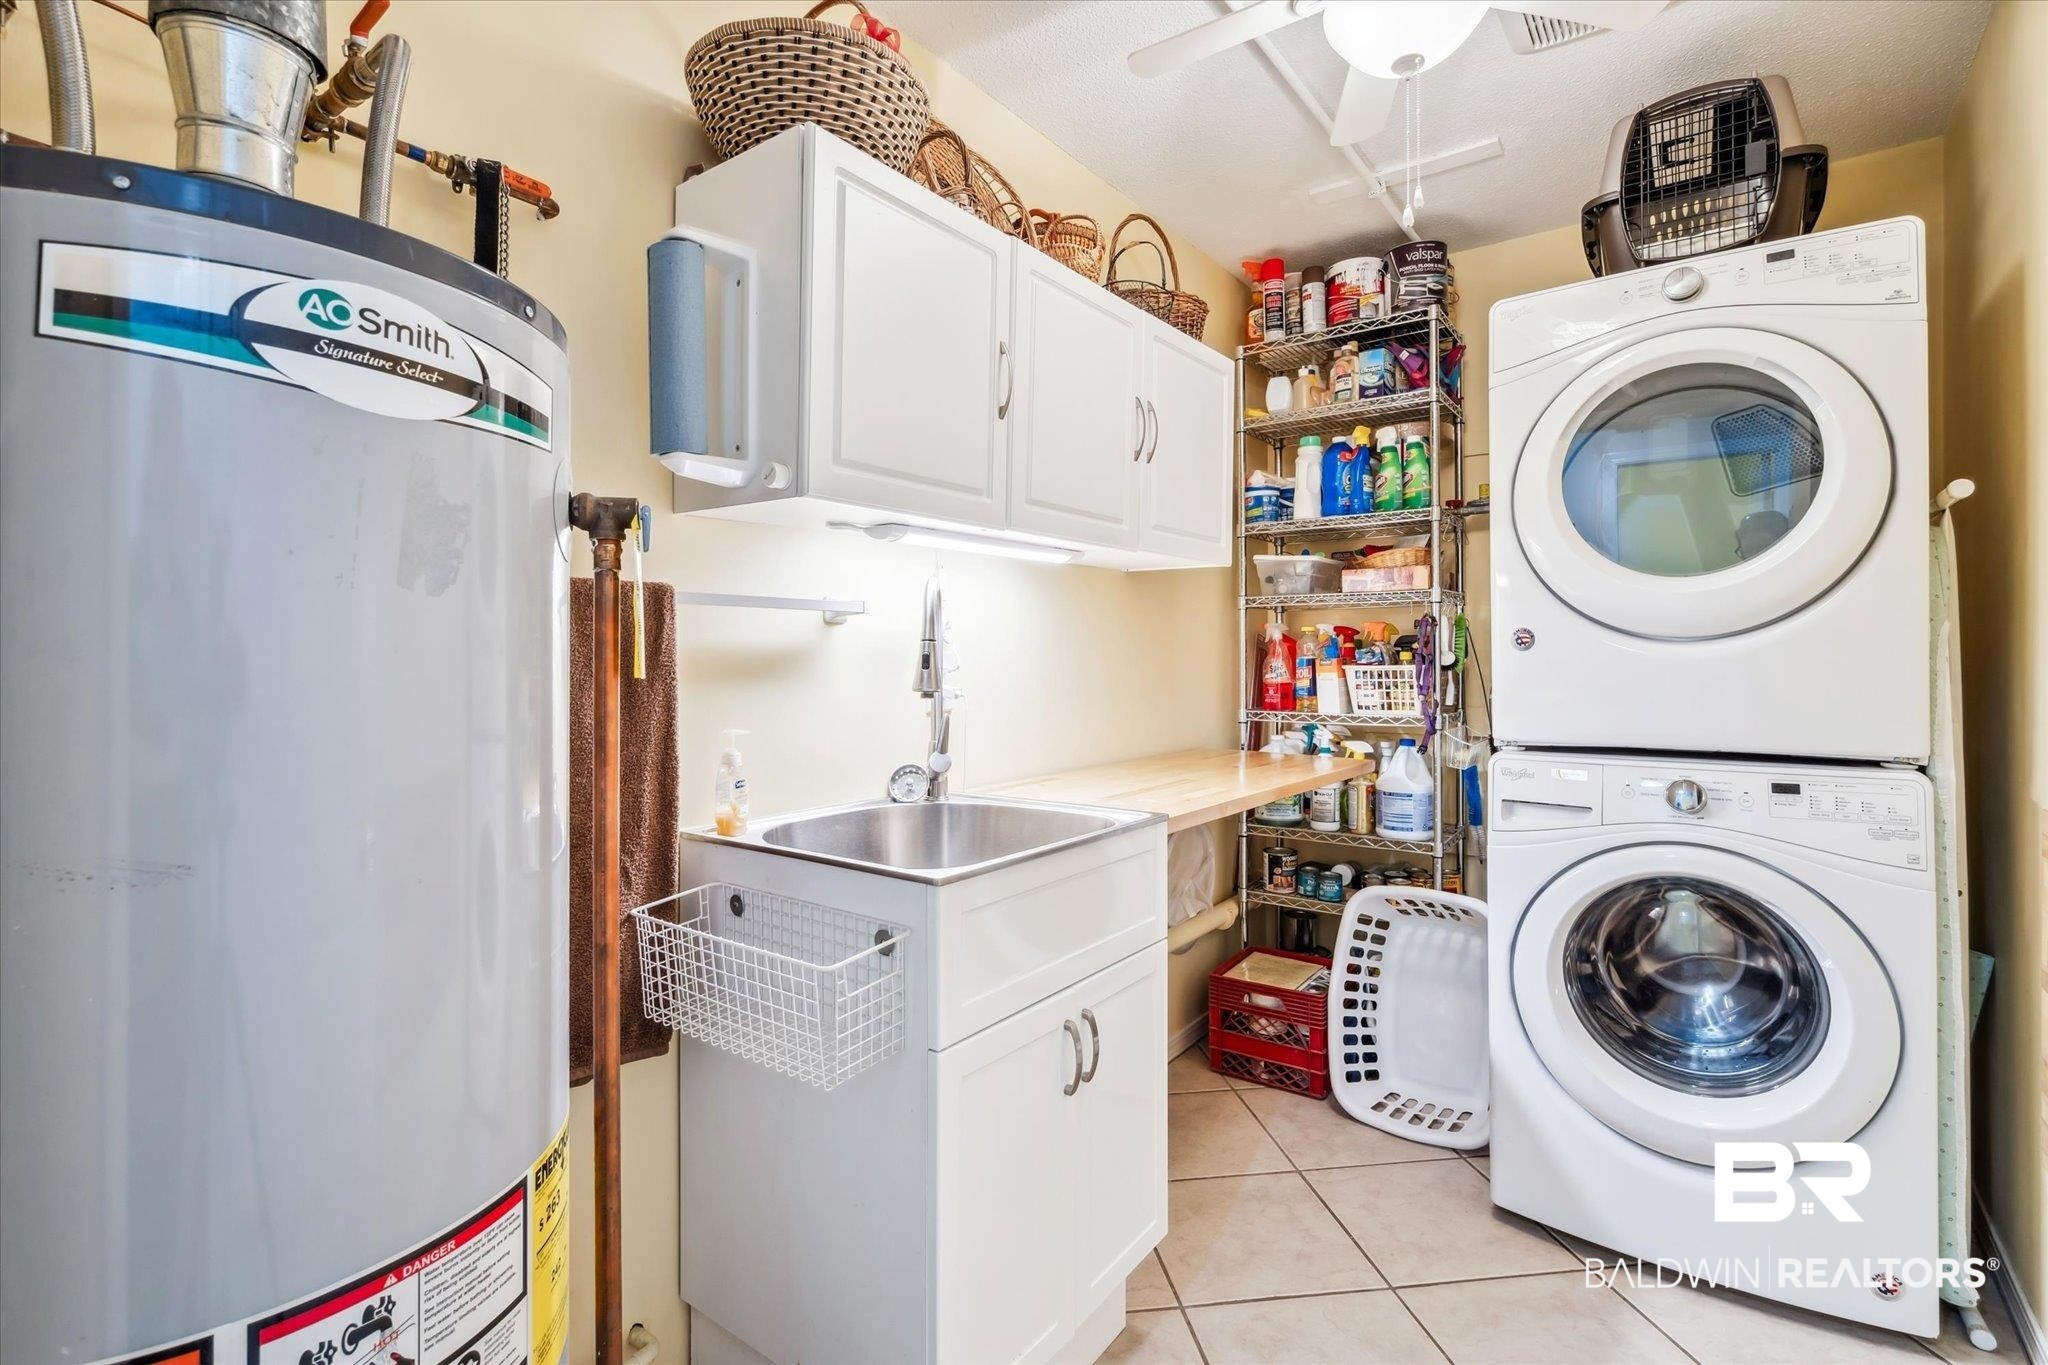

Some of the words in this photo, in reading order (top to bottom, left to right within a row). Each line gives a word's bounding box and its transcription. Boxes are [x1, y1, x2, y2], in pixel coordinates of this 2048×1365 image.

[1405, 248, 1443, 261] valspar
[357, 307, 451, 360] Smith
[314, 339, 393, 371] Signature
[396, 360, 444, 383] Select
[403, 1240, 456, 1278] DANGER
